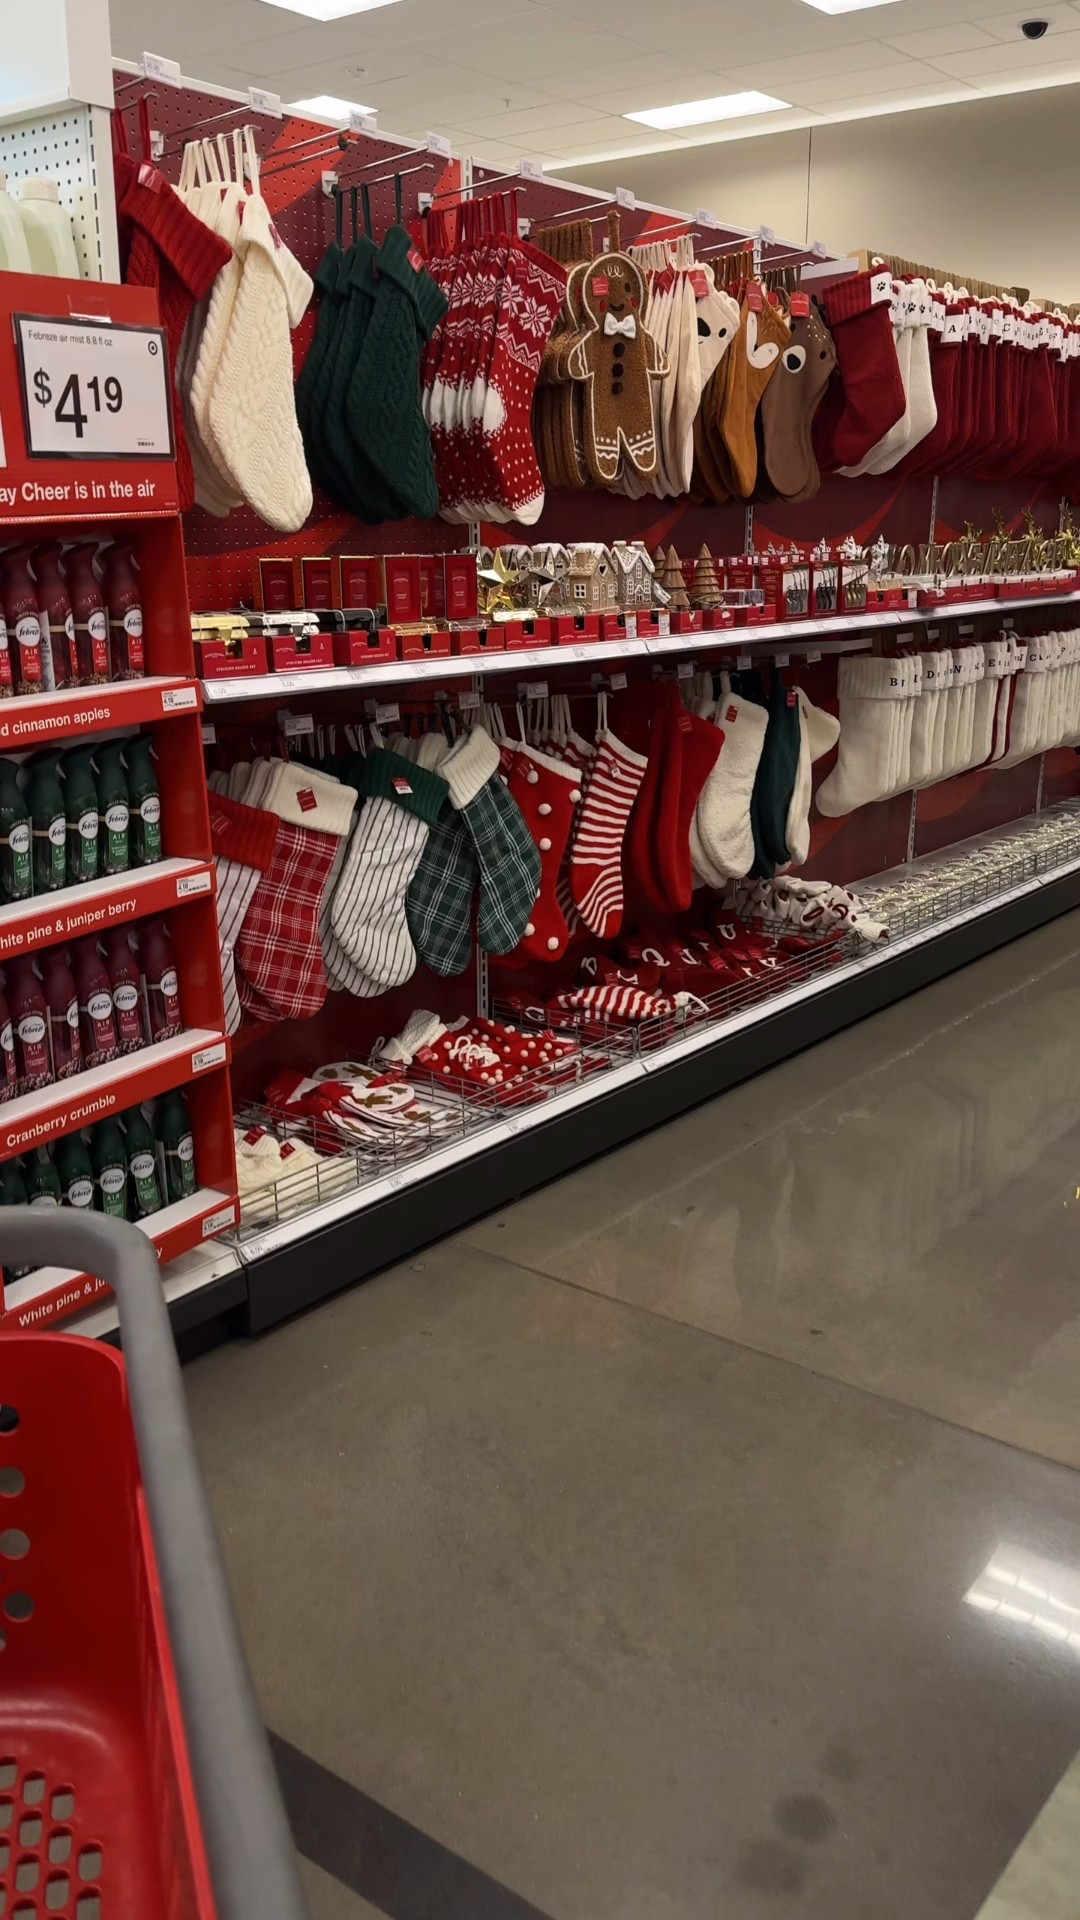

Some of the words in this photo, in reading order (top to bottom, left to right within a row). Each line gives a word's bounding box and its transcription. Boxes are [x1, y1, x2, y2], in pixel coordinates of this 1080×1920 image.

[28, 330, 58, 341] Febreze
[59, 334, 68, 342] air
[70, 335, 85, 344] mist
[22, 482, 70, 501] Cheer
[74, 481, 88, 499] is
[91, 480, 106, 498] in
[109, 480, 133, 497] the
[137, 479, 156, 496] air
[889, 678, 898, 687] B
[12, 715, 71, 734] cinnamon
[73, 707, 111, 725] apples
[26, 927, 52, 944] pine
[55, 920, 64, 932] &
[66, 909, 106, 932] juniper
[108, 899, 137, 916] berry
[6, 1115, 67, 1147] Cranberry
[70, 1094, 116, 1121] crumble
[18, 1303, 53, 1327] White
[56, 1290, 81, 1312] pine
[84, 1283, 92, 1295] &
